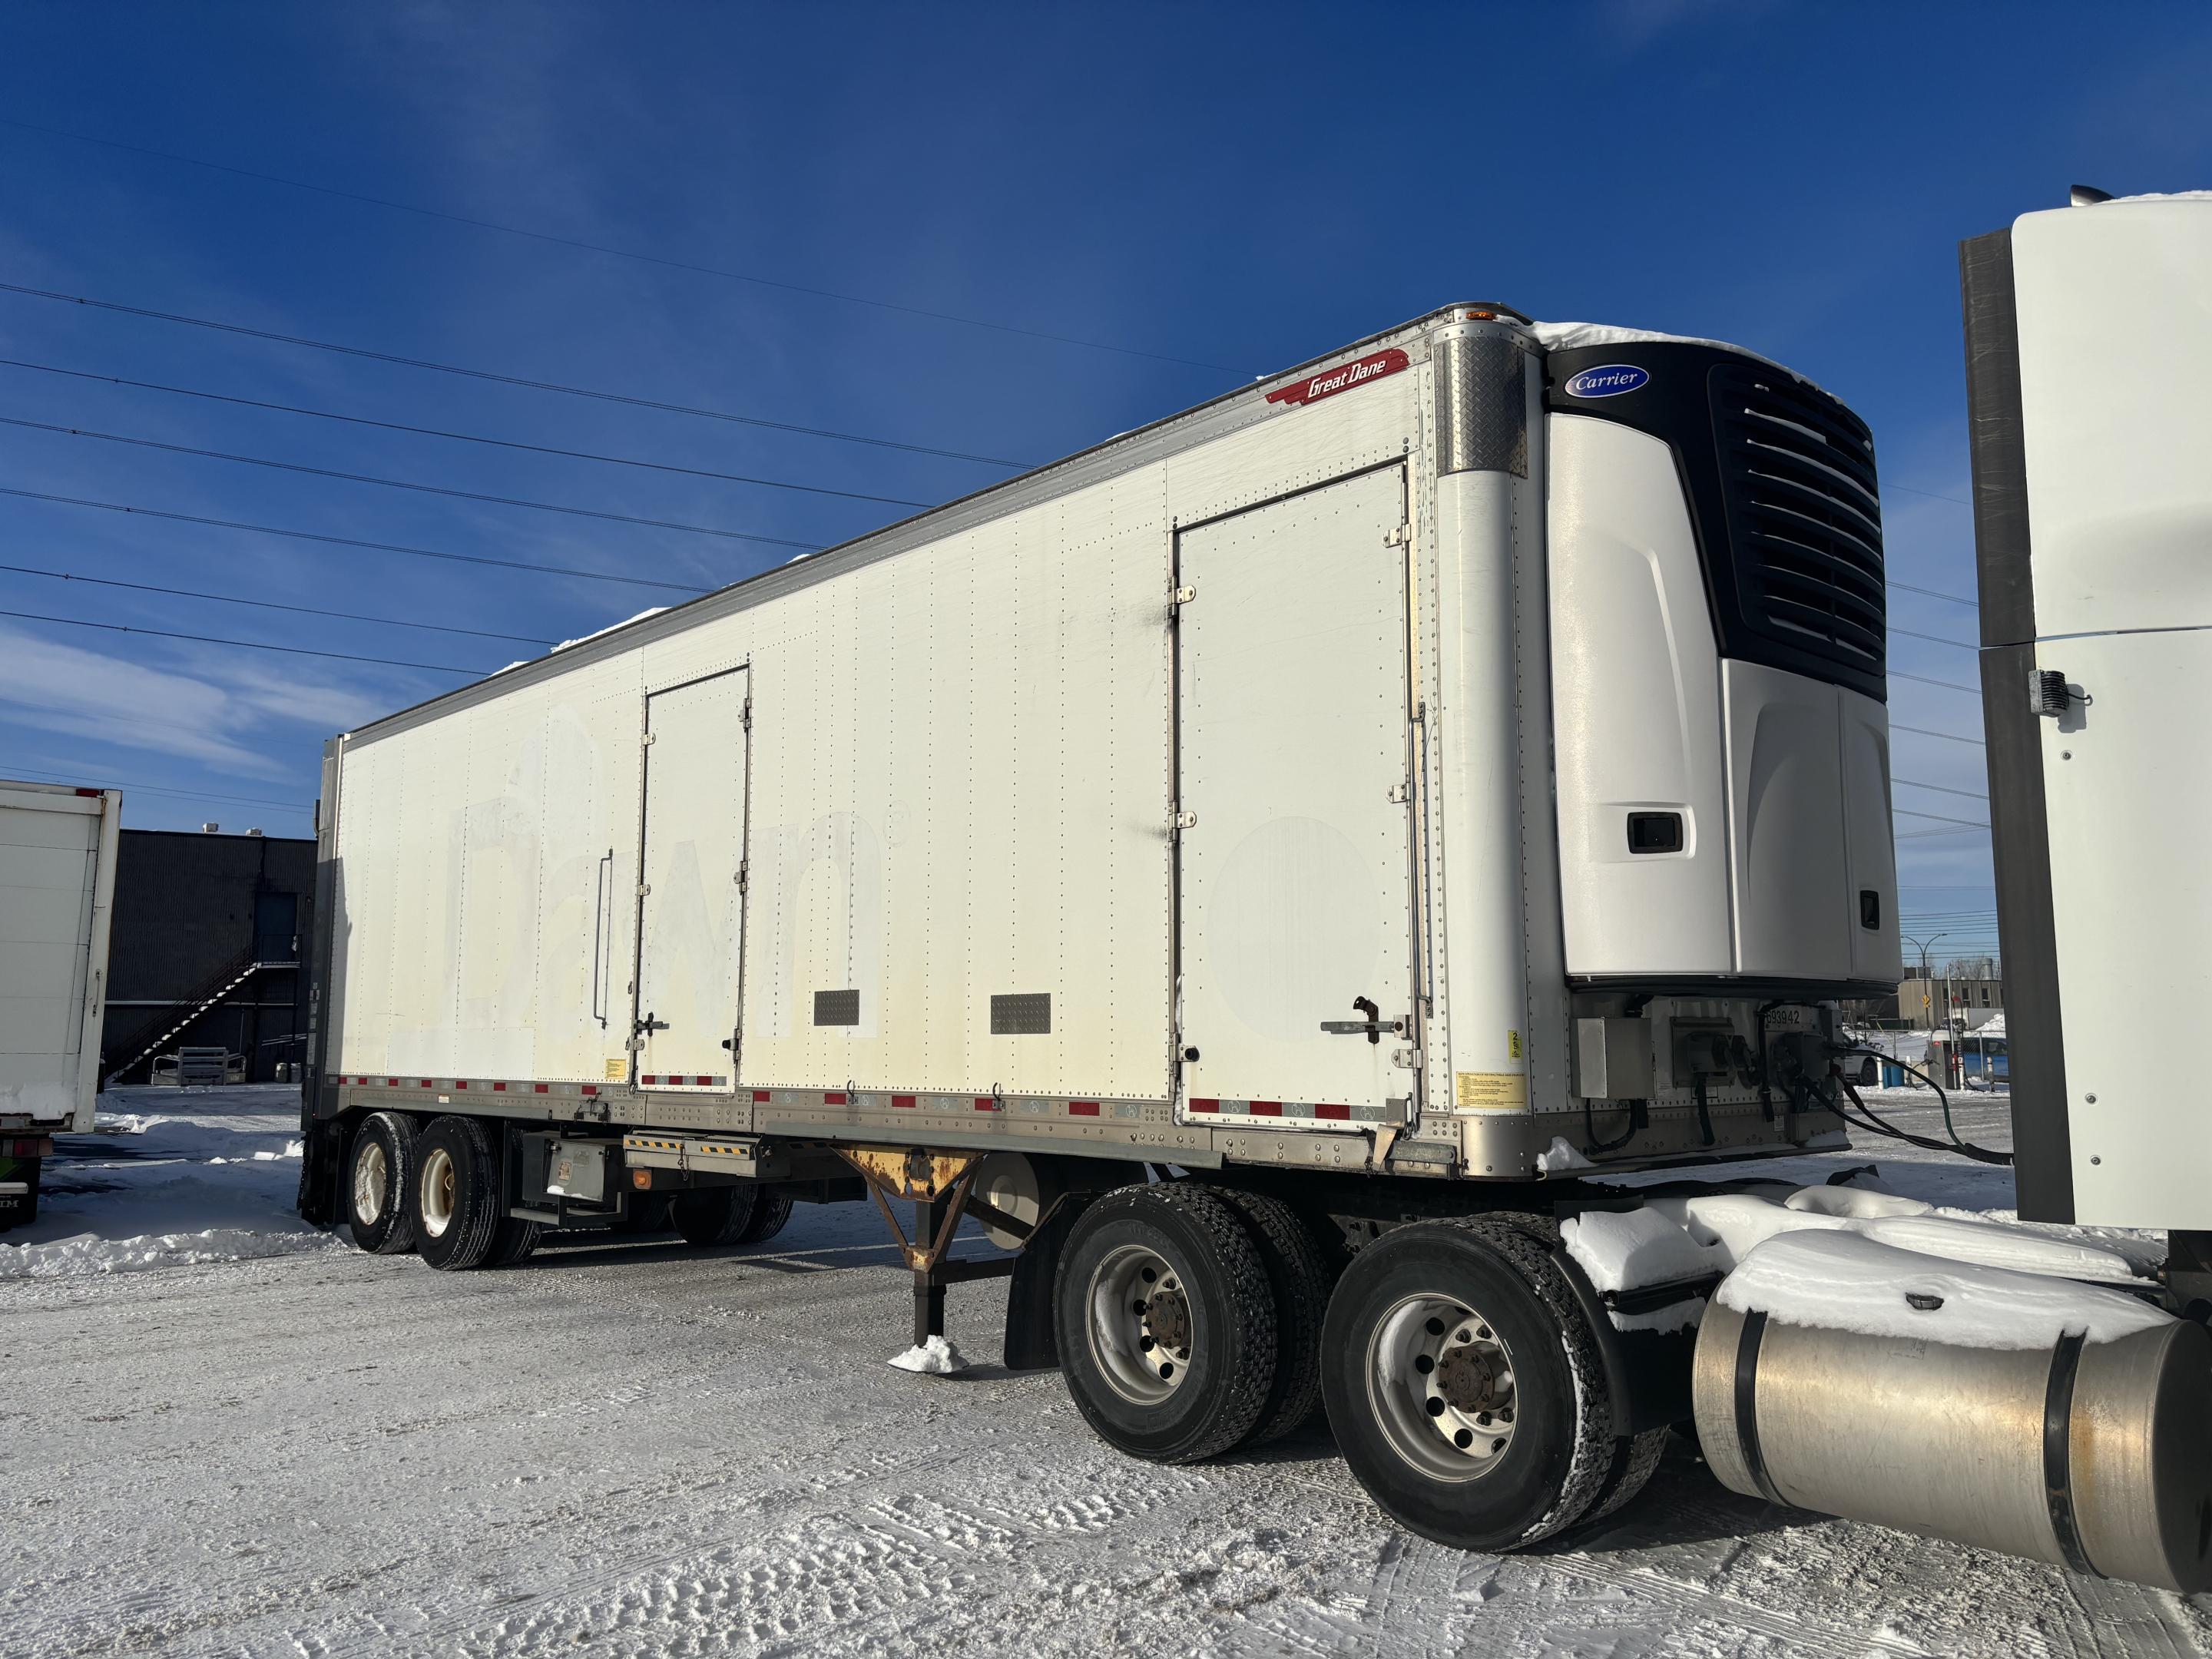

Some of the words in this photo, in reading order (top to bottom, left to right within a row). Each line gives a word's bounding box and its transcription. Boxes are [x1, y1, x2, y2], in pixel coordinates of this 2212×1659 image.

[1307, 371, 1348, 399] Great
[1347, 359, 1386, 384] Dane
[1575, 373, 1638, 390] Carrier
